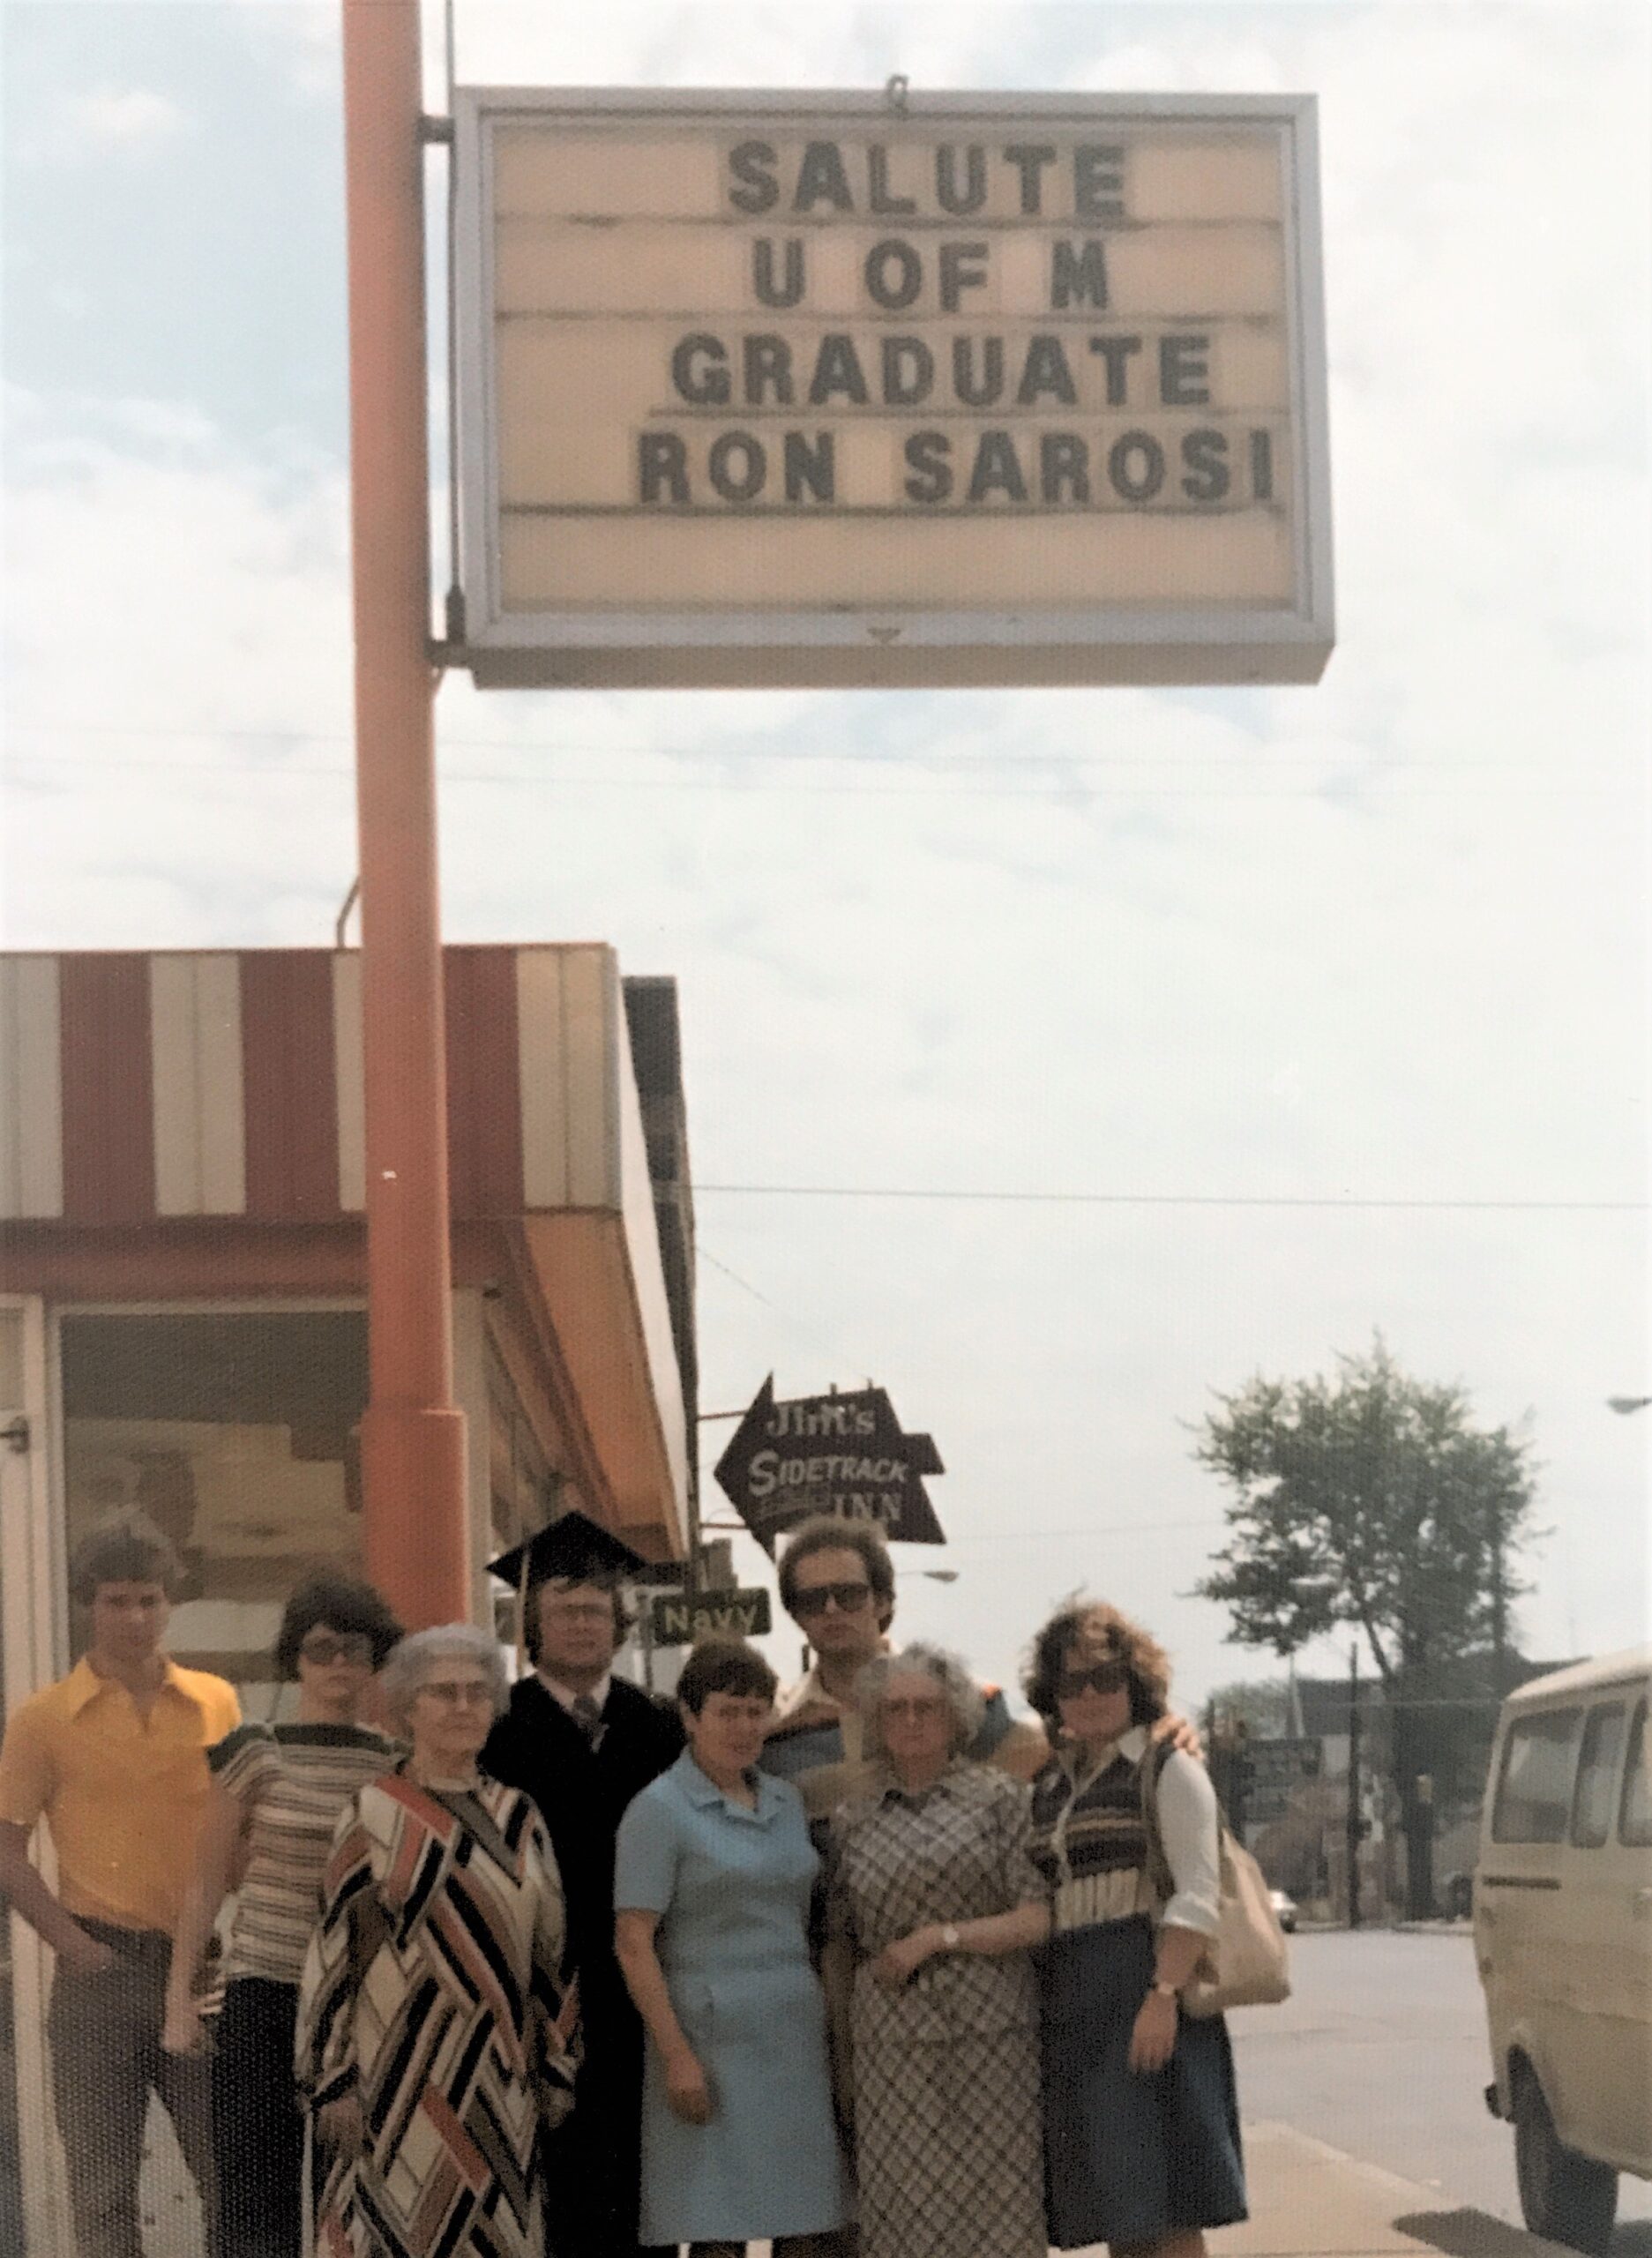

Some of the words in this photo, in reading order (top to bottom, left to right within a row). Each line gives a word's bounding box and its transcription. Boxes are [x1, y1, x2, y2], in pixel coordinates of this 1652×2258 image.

[729, 139, 1125, 216] SALUTE
[752, 237, 805, 309] U
[863, 238, 990, 312] OF
[1050, 239, 1109, 310] M
[671, 333, 1210, 407] GRADUATE
[637, 430, 835, 504] RON
[901, 430, 1273, 504] SAROSI
[749, 1449, 908, 1496] SIDETRACK
[833, 1492, 903, 1522] INN
